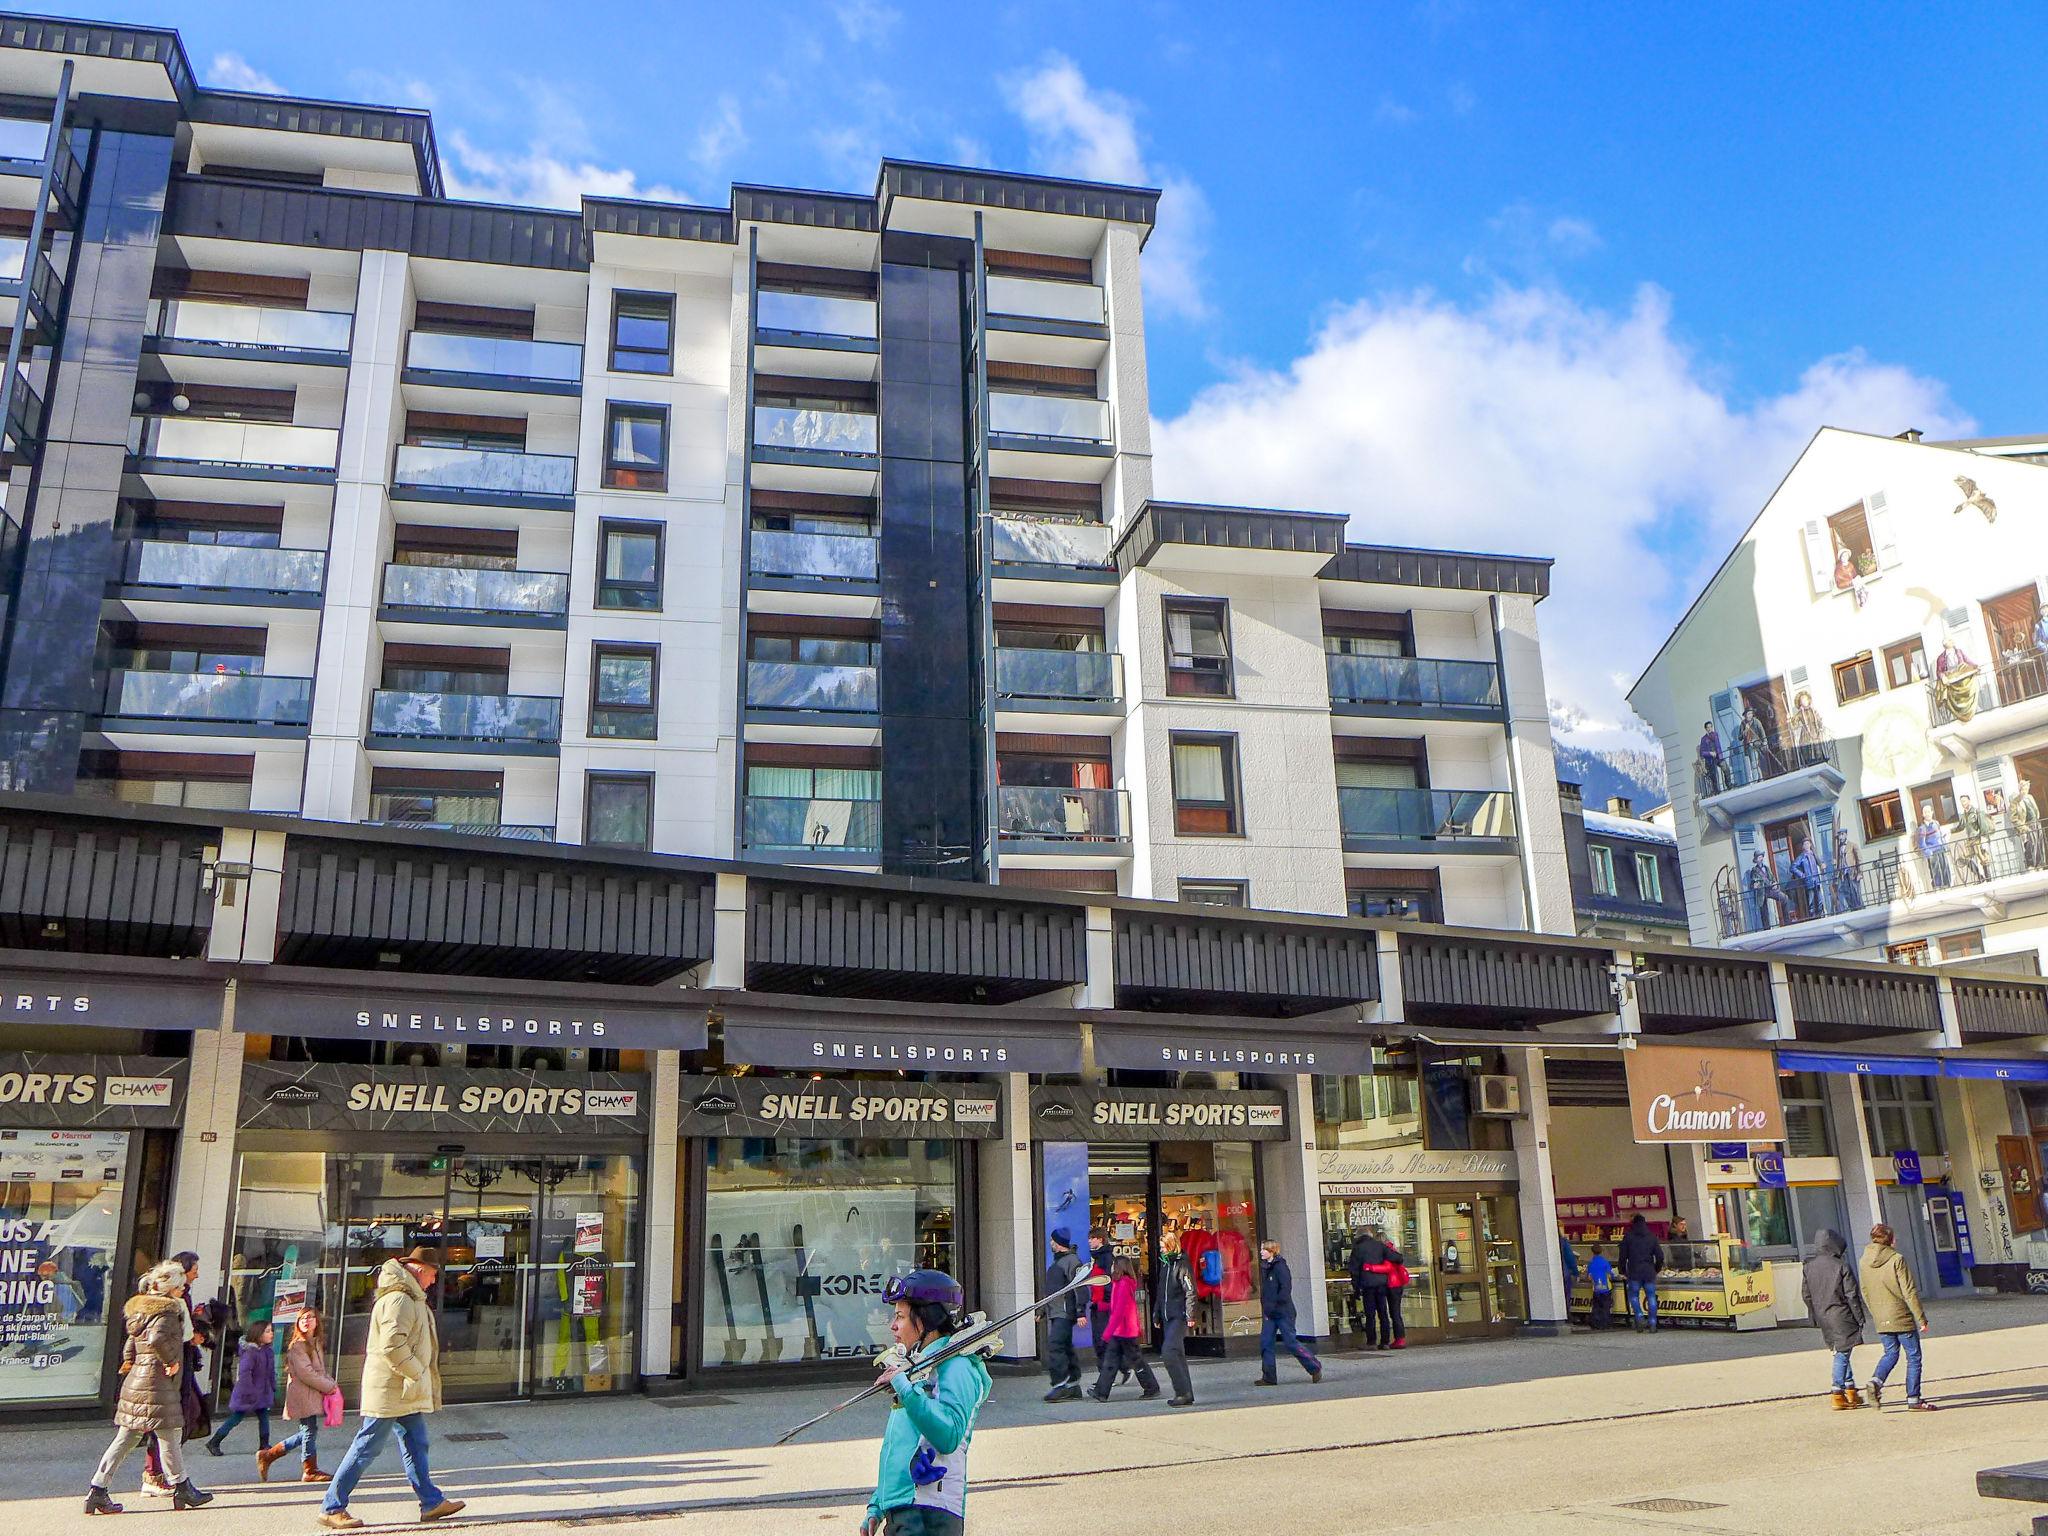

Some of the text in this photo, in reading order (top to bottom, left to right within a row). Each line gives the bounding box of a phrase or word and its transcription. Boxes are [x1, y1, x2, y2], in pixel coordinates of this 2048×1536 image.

[356, 1011, 606, 1036] SNELLSPORTS
[812, 1042, 1008, 1061] SNELLSPORTS
[1162, 1048, 1316, 1065] SNELLSPORTS
[1856, 1063, 1871, 1072] LCL
[1996, 1070, 2010, 1078] LCL
[347, 1083, 583, 1115] SNELL SPORTS
[759, 1095, 949, 1122] SNELL SPORTS
[1093, 1102, 1245, 1126] SNELL SPORTS
[1647, 1093, 1767, 1134] Chamon'ice
[1759, 1159, 1782, 1171] LCL
[1898, 1158, 1918, 1169] LCL
[1327, 1184, 1385, 1194] VICTORINOX
[1350, 1207, 1388, 1217] ARTISAN
[820, 1343, 887, 1357] HEAD
